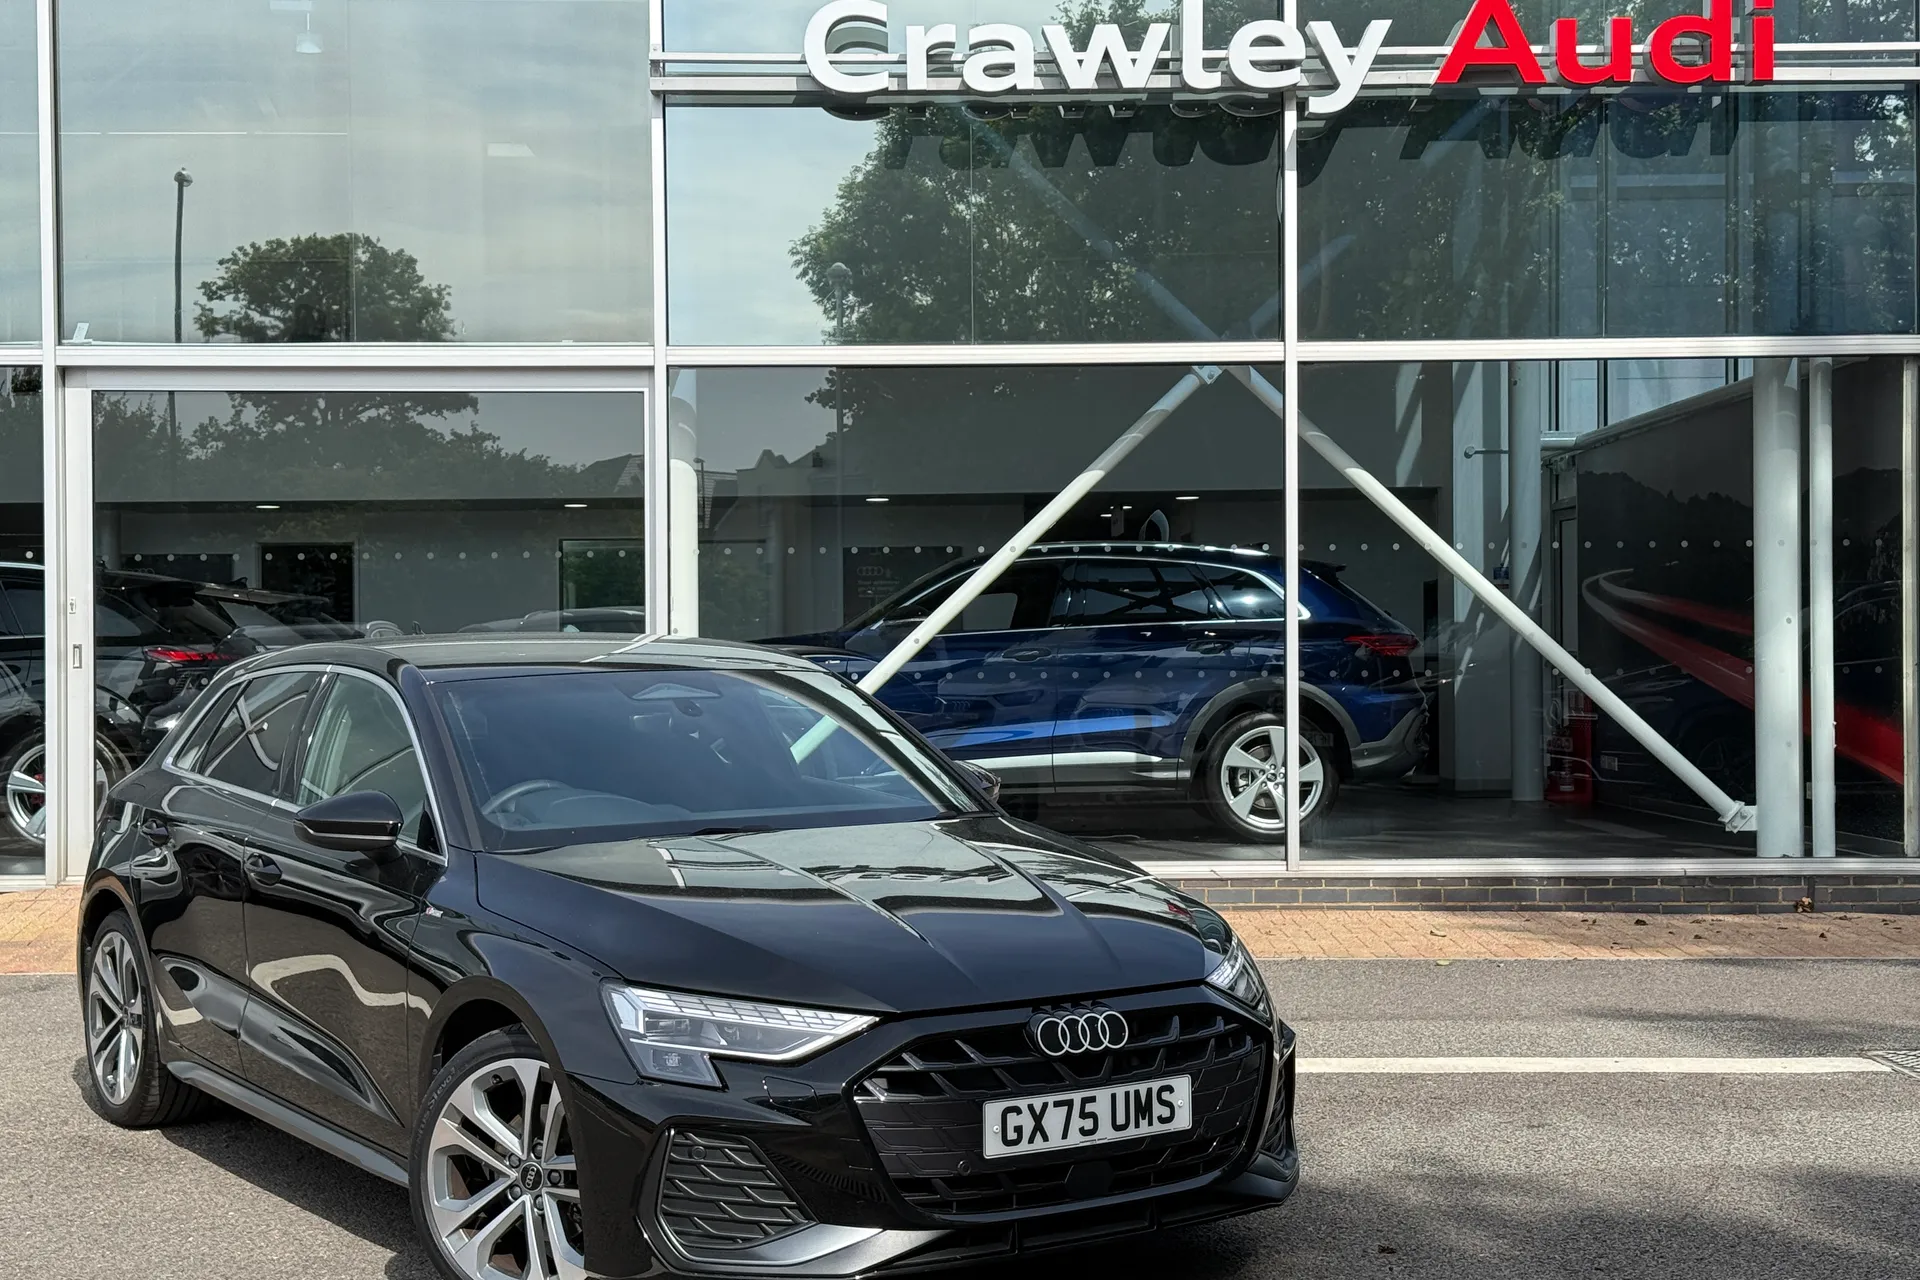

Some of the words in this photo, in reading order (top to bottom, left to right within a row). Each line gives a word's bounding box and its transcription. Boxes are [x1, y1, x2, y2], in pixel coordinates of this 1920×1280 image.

[803, 0, 1393, 115] Crawley
[1435, 0, 1775, 85] Audi
[1001, 1095, 1099, 1147] GX75
[1111, 1084, 1176, 1132] UMS
